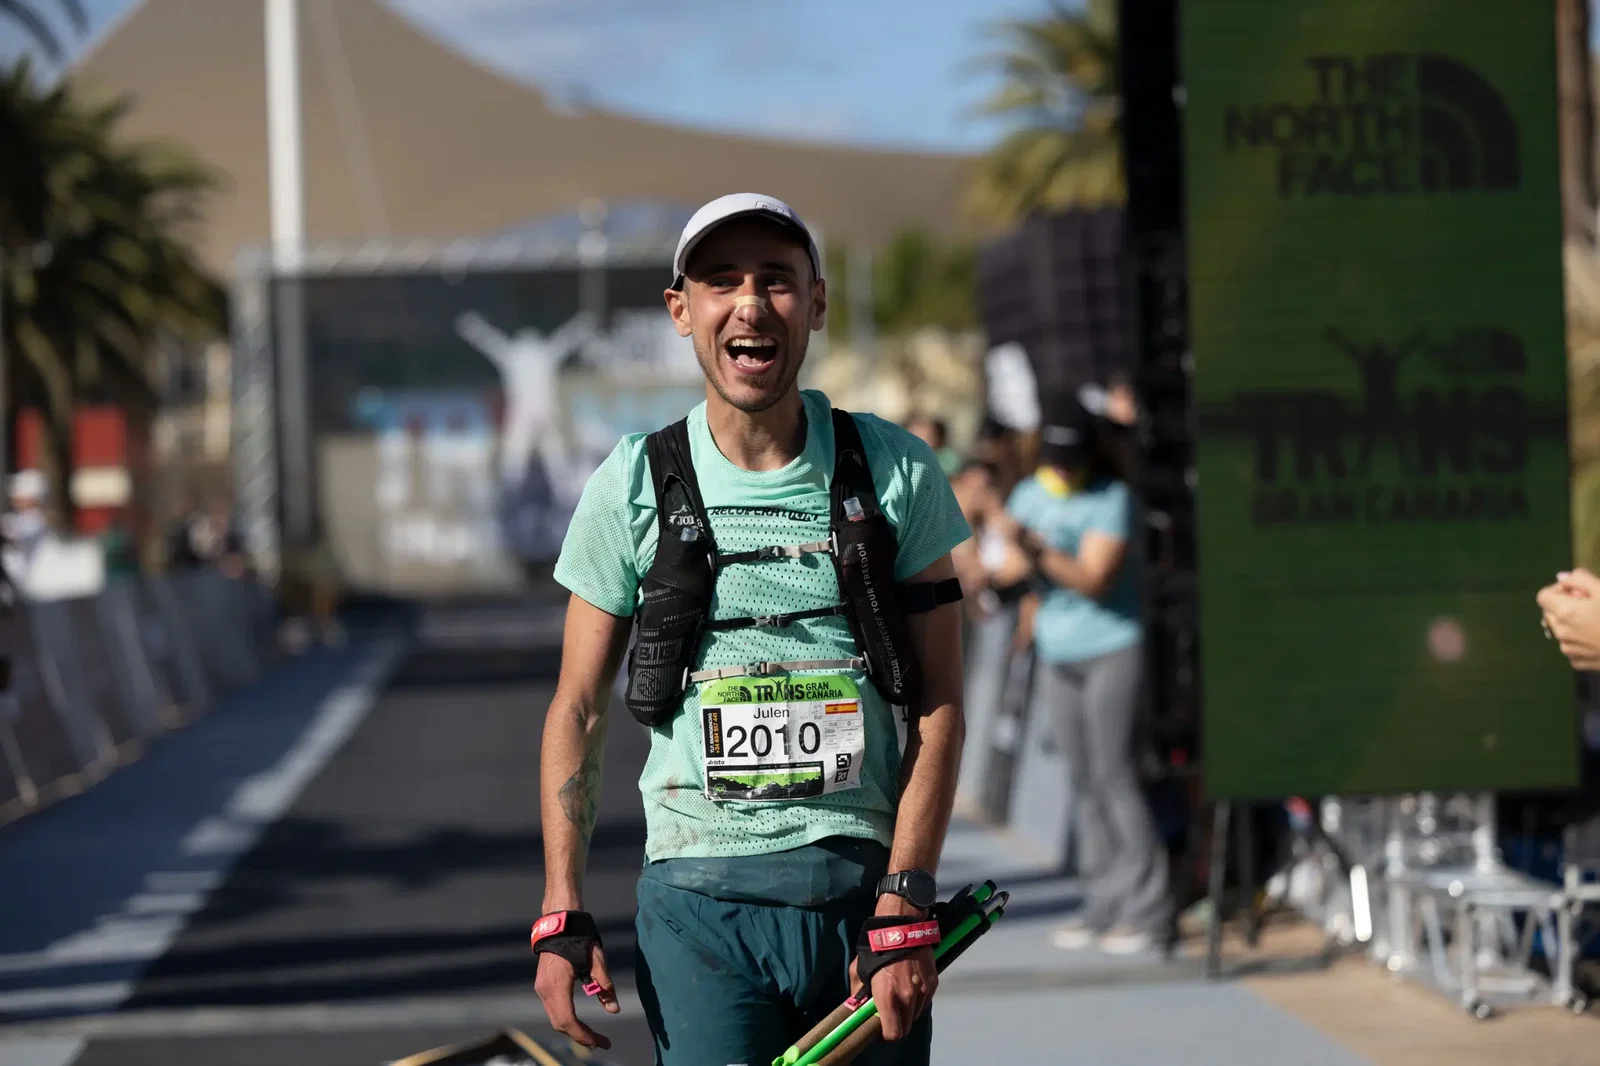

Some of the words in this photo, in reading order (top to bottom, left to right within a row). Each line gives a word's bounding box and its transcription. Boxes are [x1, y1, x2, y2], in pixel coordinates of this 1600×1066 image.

[1305, 56, 1411, 98] THE
[1223, 105, 1412, 150] NORTH
[1279, 152, 1411, 195] FACE
[856, 542, 872, 586] FREEDOM
[867, 587, 880, 613] YOUR
[805, 682, 829, 691] GRAN
[806, 689, 843, 700] CANARIA
[753, 707, 790, 719] Julen
[726, 722, 821, 758] 2010
